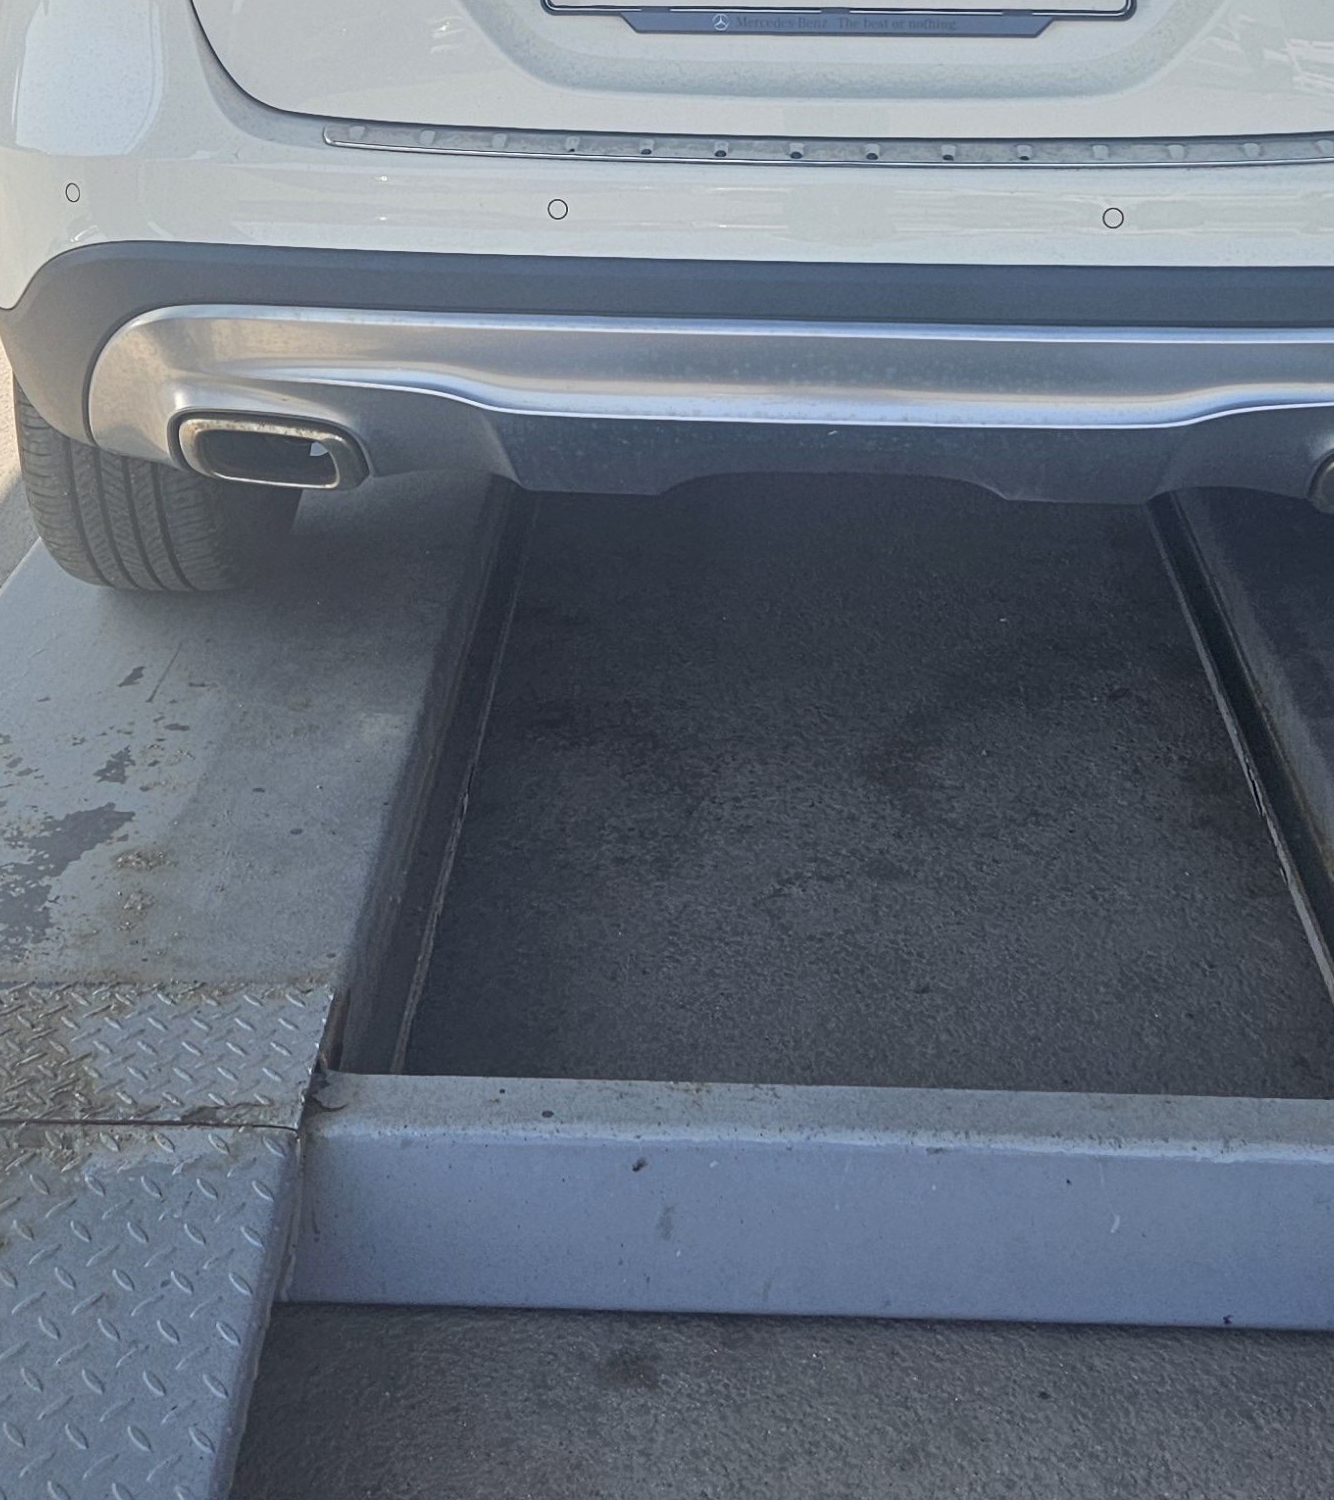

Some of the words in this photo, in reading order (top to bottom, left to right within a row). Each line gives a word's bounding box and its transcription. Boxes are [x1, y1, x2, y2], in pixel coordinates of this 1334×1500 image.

[736, 17, 828, 30] Mercedes-Benz
[838, 18, 859, 29] The
[864, 18, 889, 30] best
[892, 21, 906, 30] or
